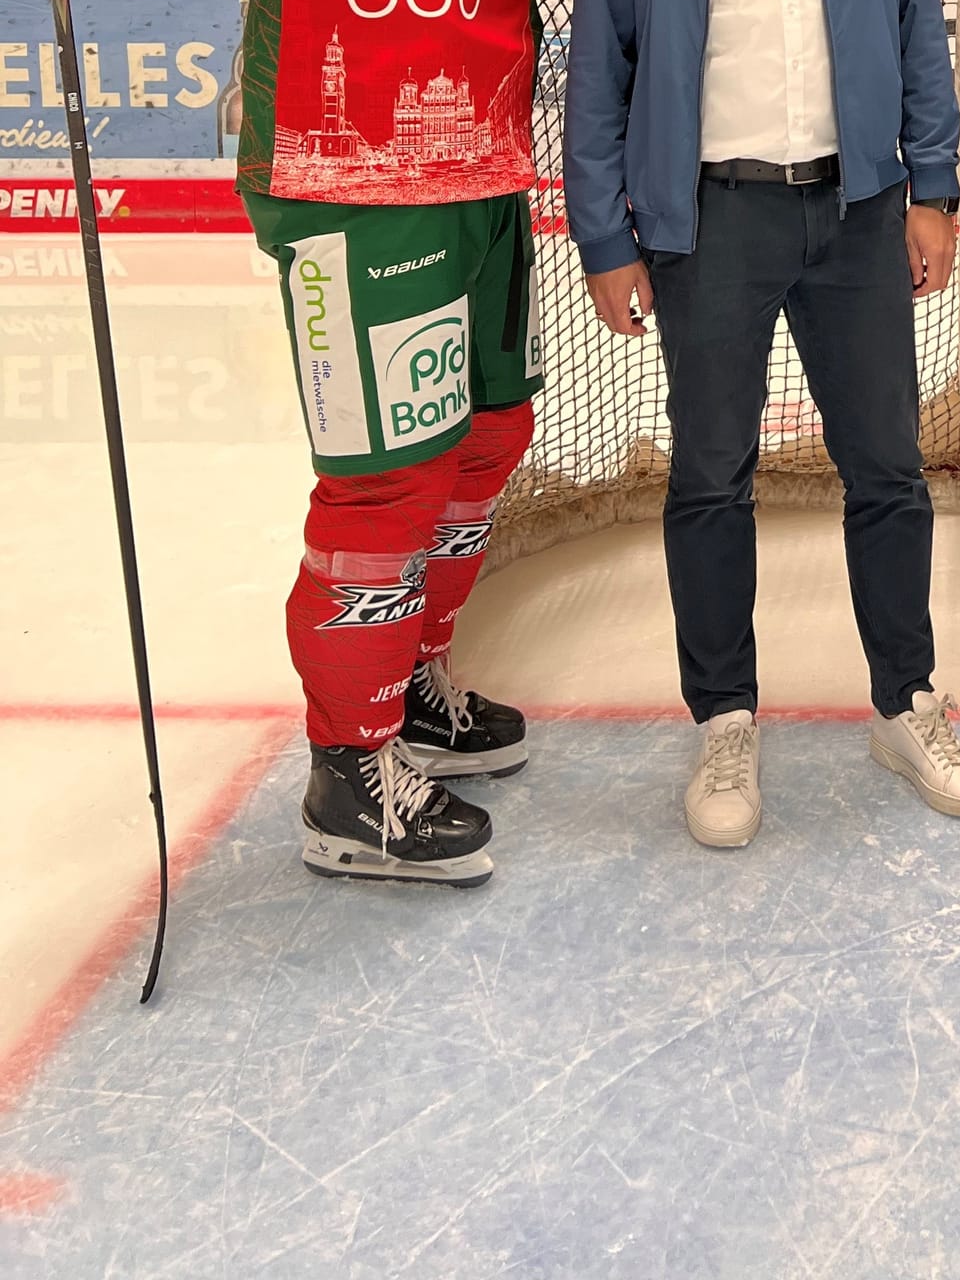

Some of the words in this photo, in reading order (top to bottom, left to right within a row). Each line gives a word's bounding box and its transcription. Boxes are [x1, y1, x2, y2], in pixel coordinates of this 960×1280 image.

[383, 249, 447, 278] BAUER
[322, 360, 331, 379] die
[408, 329, 466, 392] psd
[311, 360, 327, 433] mietwäsche
[390, 378, 468, 436] Bank
